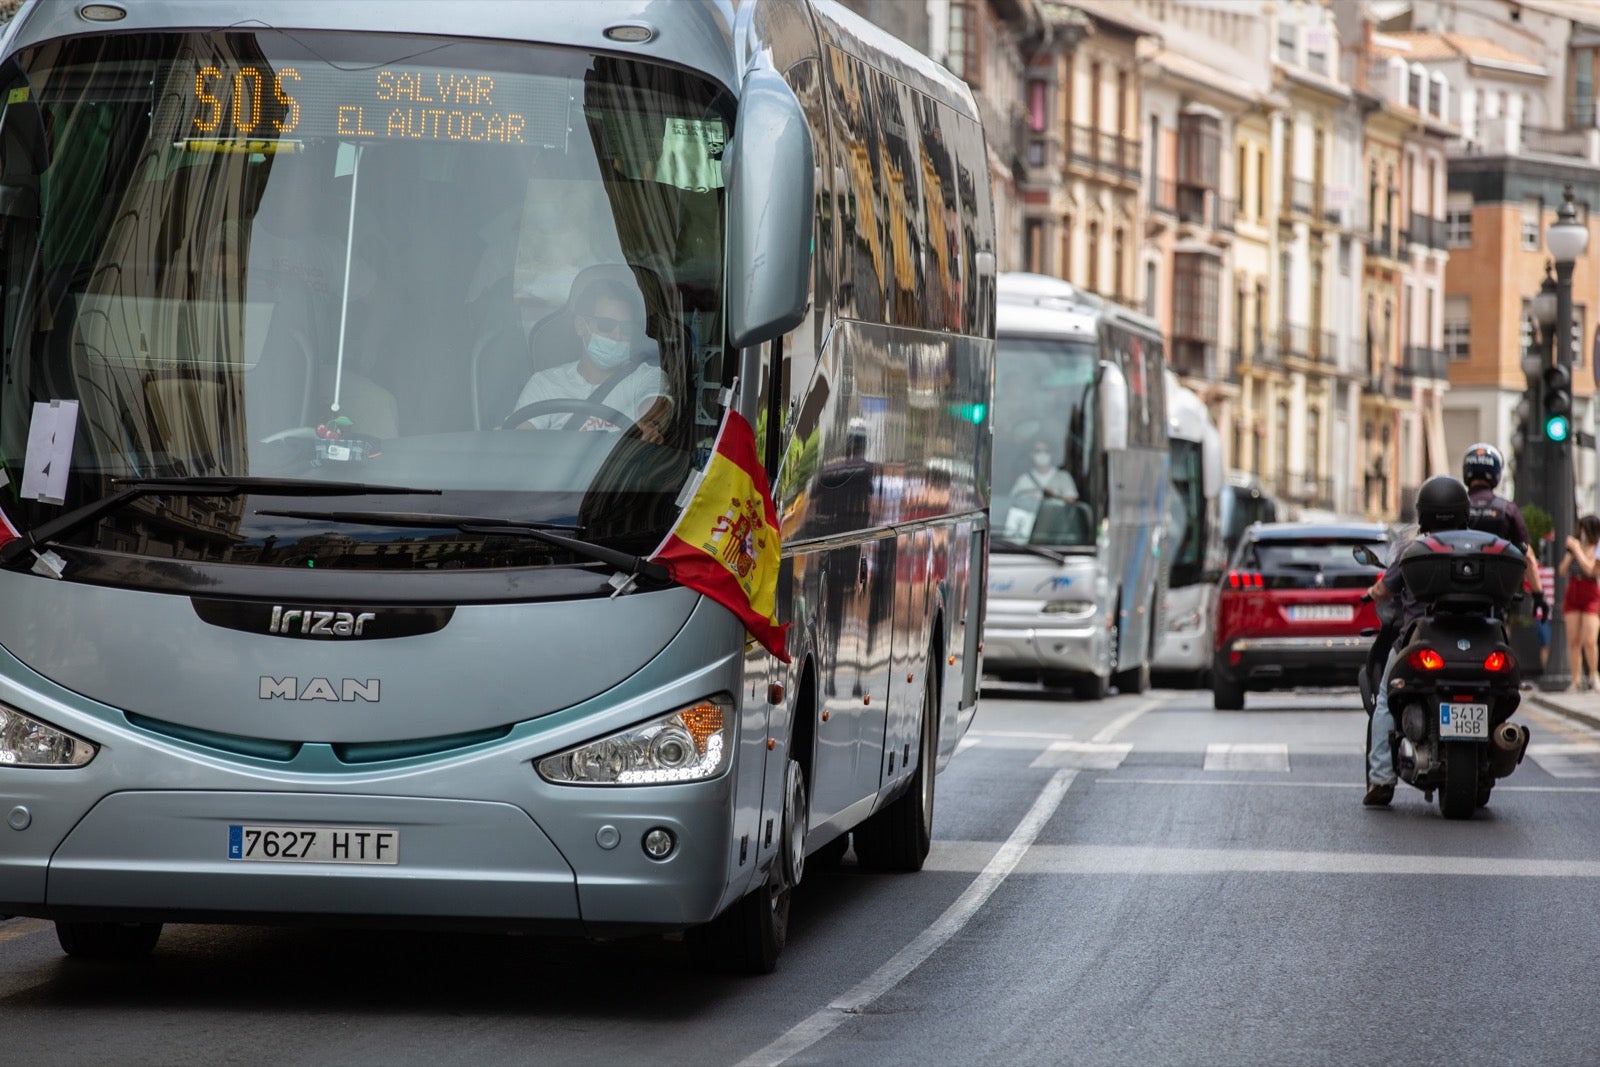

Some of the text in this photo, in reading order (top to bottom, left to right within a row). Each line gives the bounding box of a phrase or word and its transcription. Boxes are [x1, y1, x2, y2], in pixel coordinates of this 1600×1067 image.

[193, 66, 301, 132] SOS
[376, 70, 494, 105] SALVAR
[337, 106, 526, 143] EL AUTOCAR
[269, 605, 376, 636] Irizar
[259, 675, 380, 702] MAN
[1450, 706, 1484, 721] 5412
[1455, 720, 1481, 734] HSB
[232, 845, 239, 853] E
[245, 830, 393, 860] 7627 HTF
